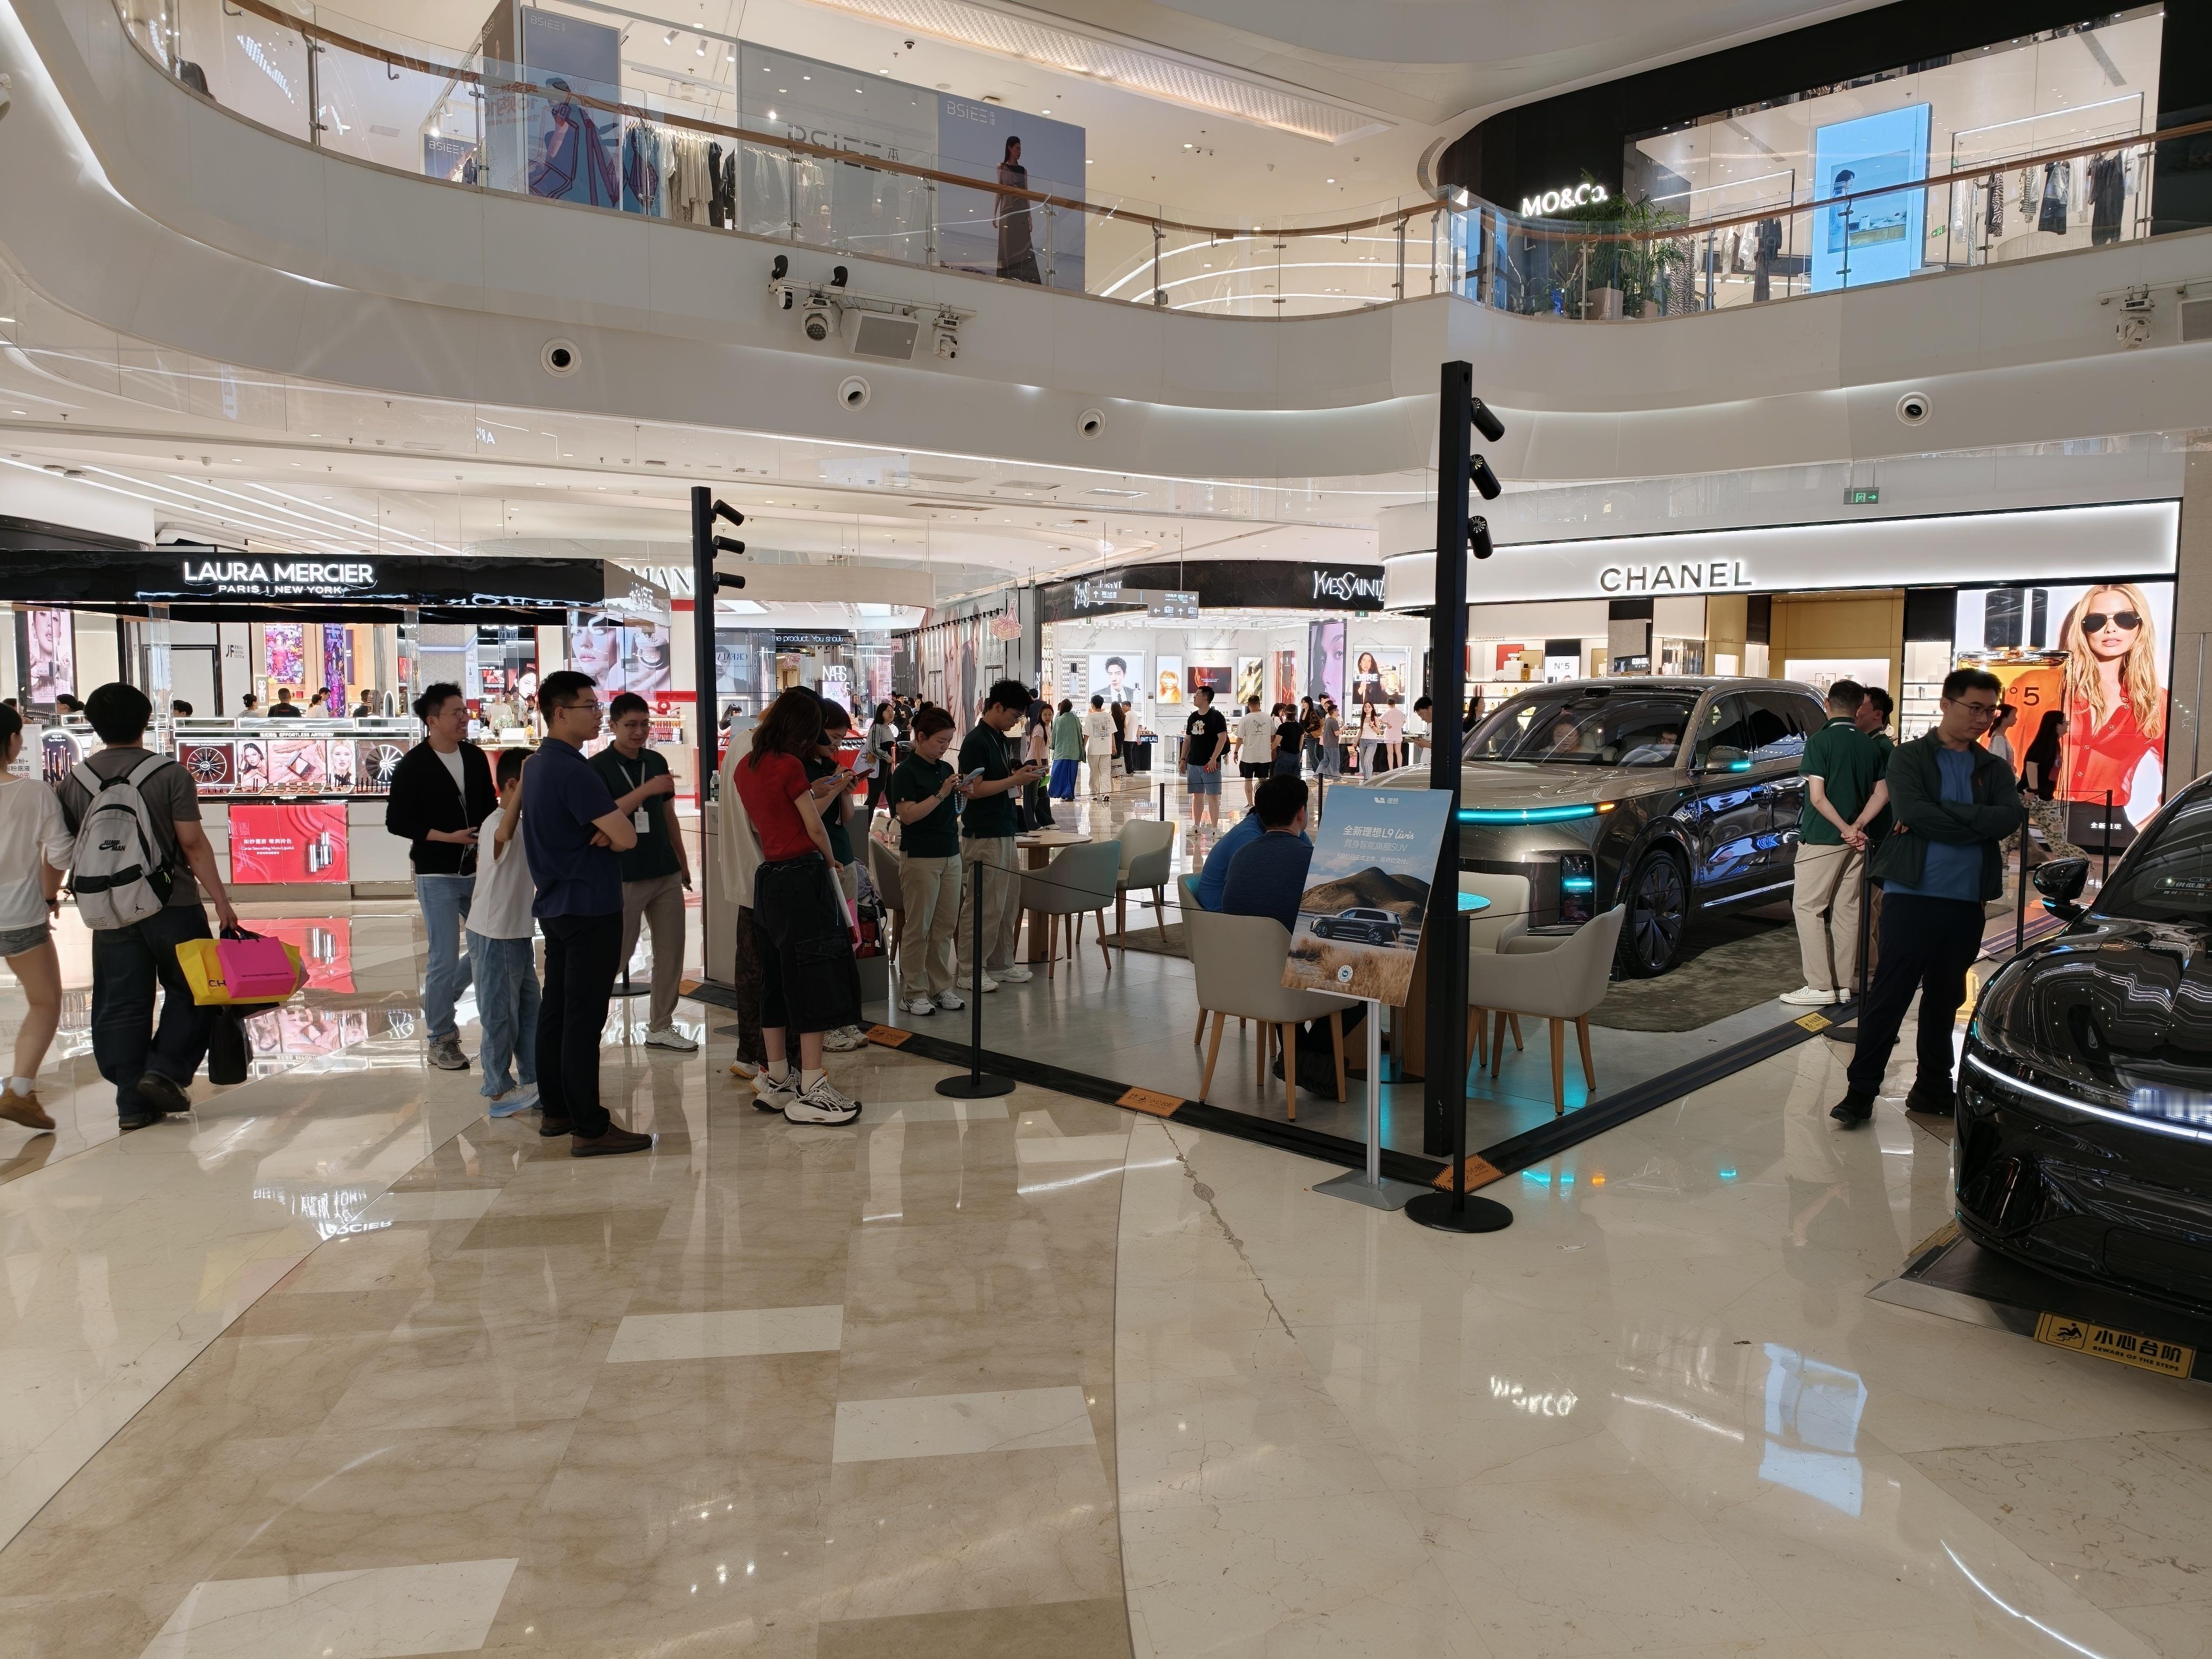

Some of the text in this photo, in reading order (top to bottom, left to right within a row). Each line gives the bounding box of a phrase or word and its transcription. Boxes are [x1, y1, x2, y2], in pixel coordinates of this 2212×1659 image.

[1522, 183, 1608, 217] MO&Co.
[184, 562, 374, 583] LAURA MERCIER
[1600, 562, 1752, 592] CHANEL
[218, 585, 341, 594] PARIS NEW YORK
[783, 635, 810, 643] product.
[822, 665, 847, 682] NARS
[2093, 1345, 2125, 1358] BEWARE
[2139, 1357, 2154, 1365] THE
[2155, 1361, 2180, 1372] STEPS
[2094, 1330, 2182, 1363] 小心台阶
